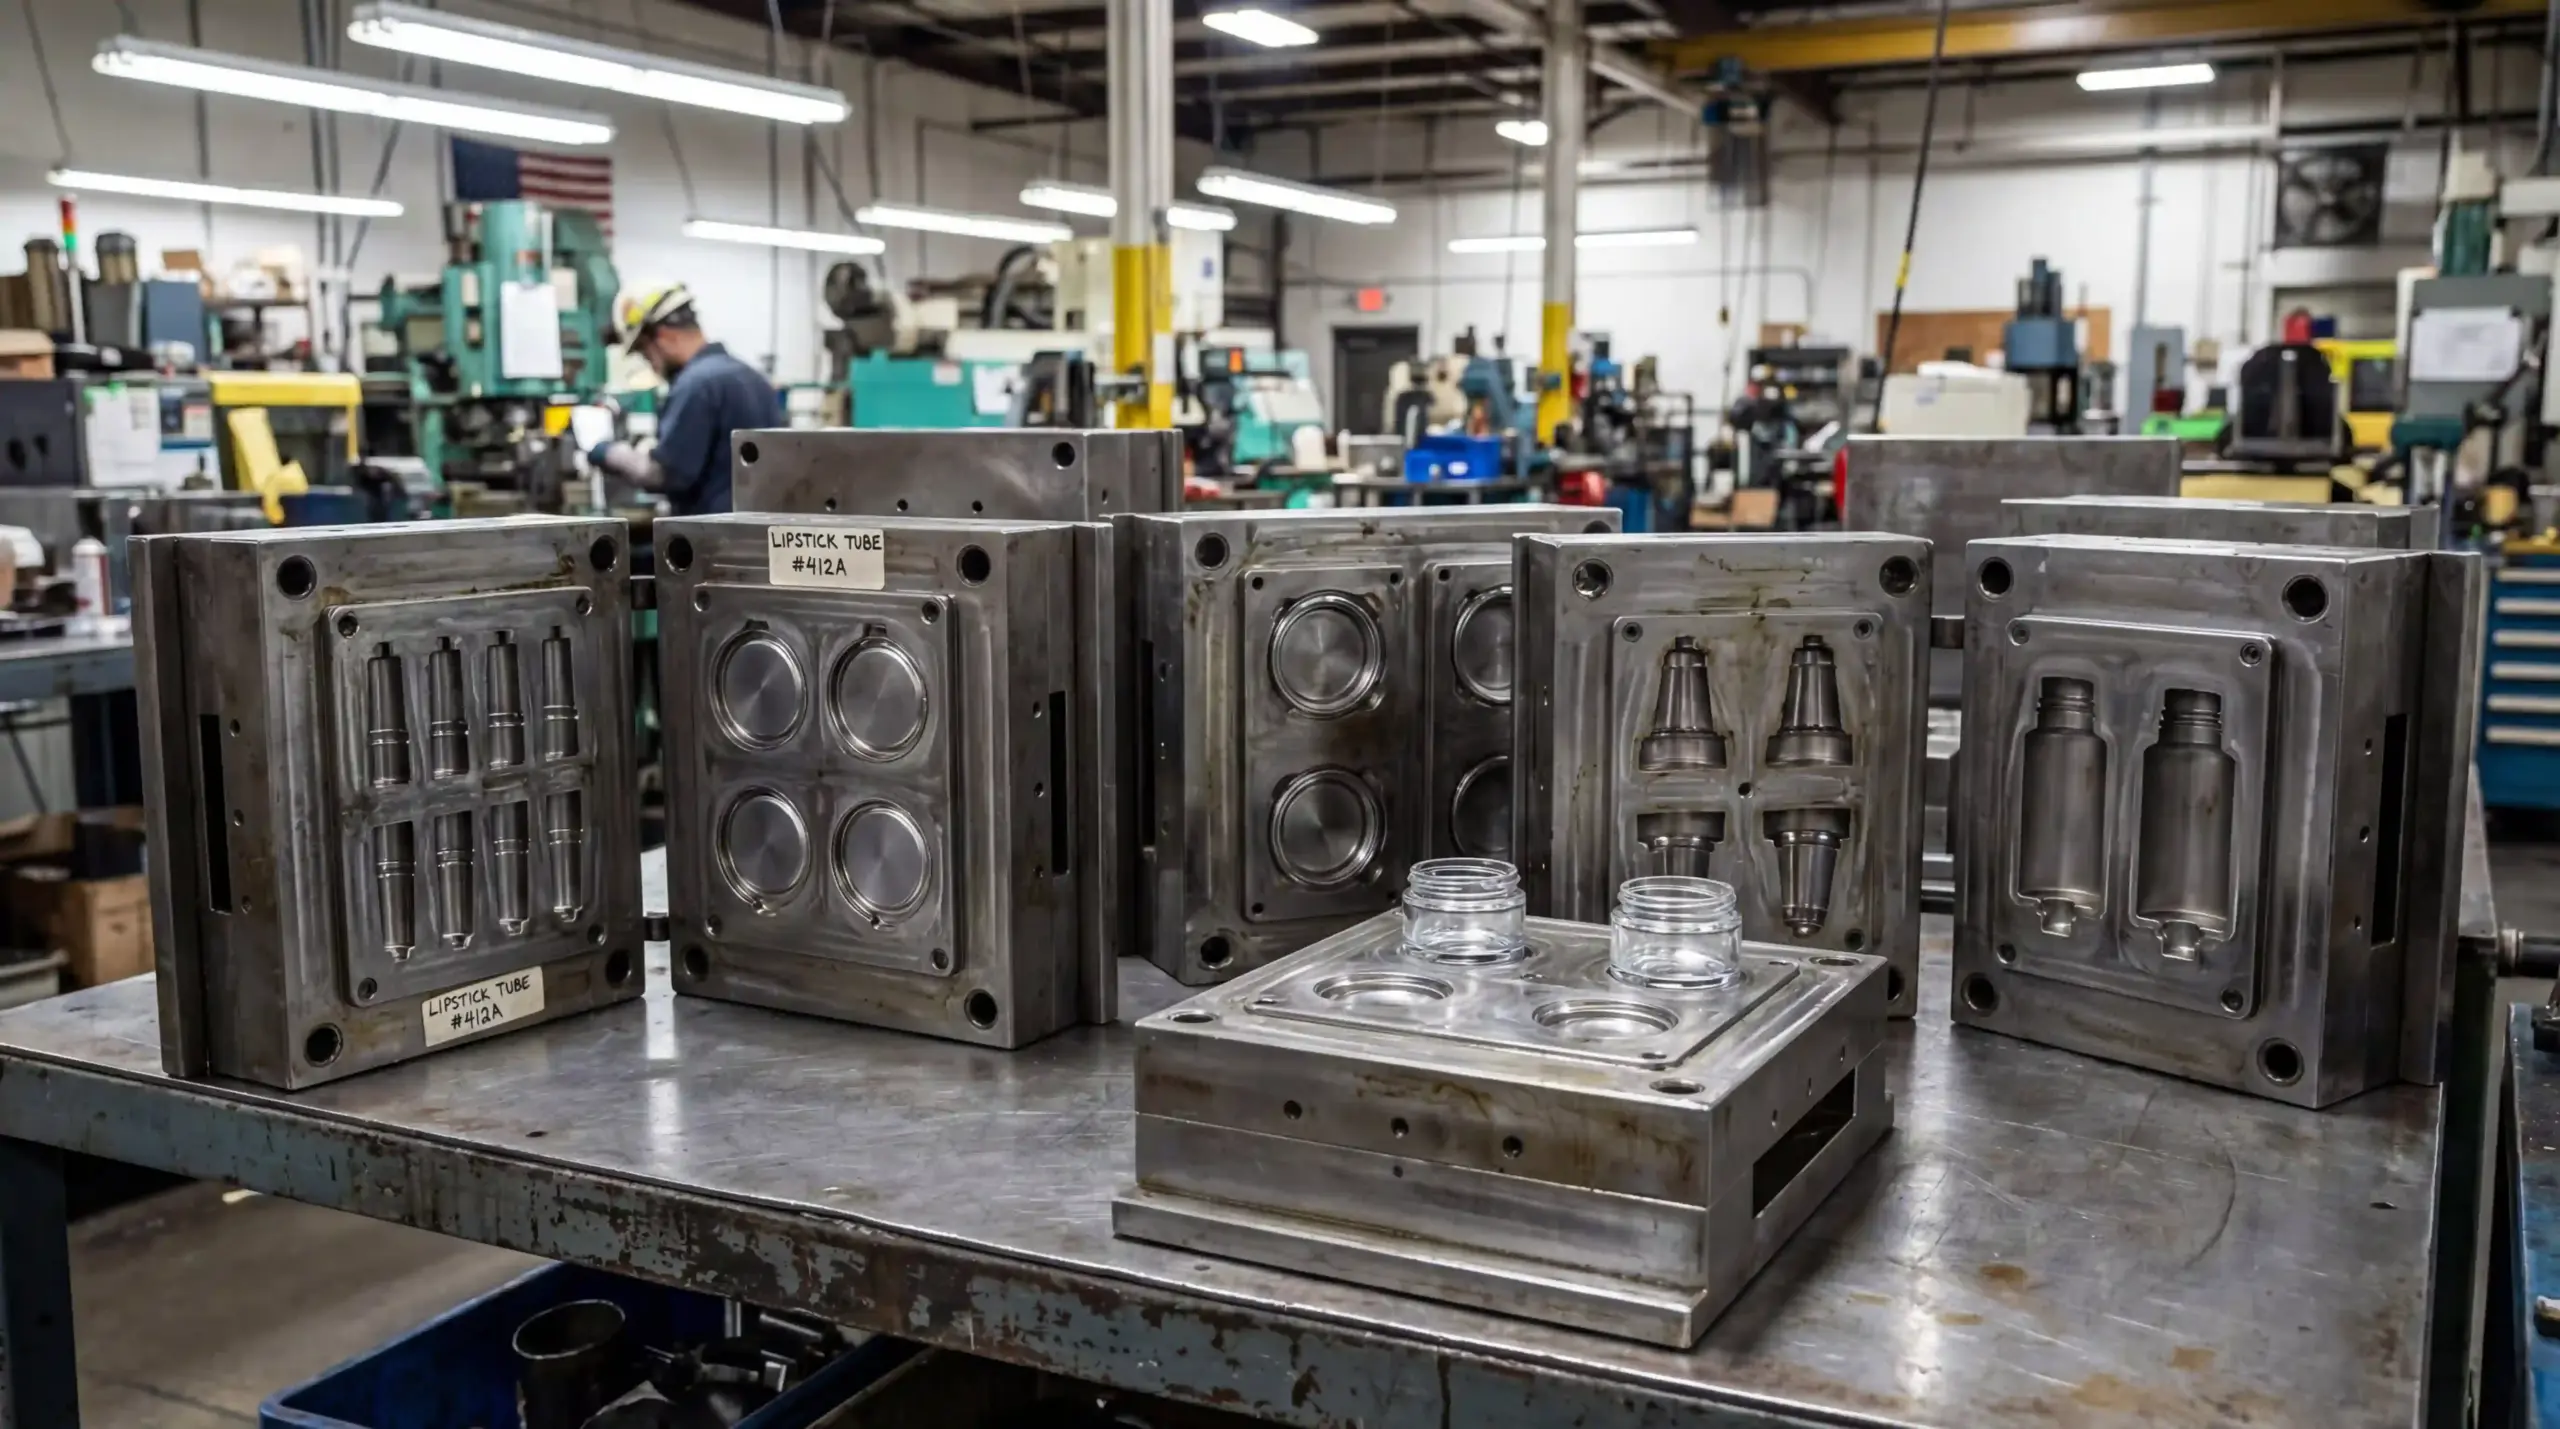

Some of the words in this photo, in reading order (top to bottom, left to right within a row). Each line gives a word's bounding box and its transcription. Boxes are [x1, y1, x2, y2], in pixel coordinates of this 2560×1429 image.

[771, 532, 838, 549] LIPSTICK
[844, 534, 882, 550] TUBE
[792, 556, 847, 576] #412A
[429, 988, 490, 1017] LIPSTICK
[495, 975, 531, 996] TUBE
[451, 1003, 503, 1029] #412A
